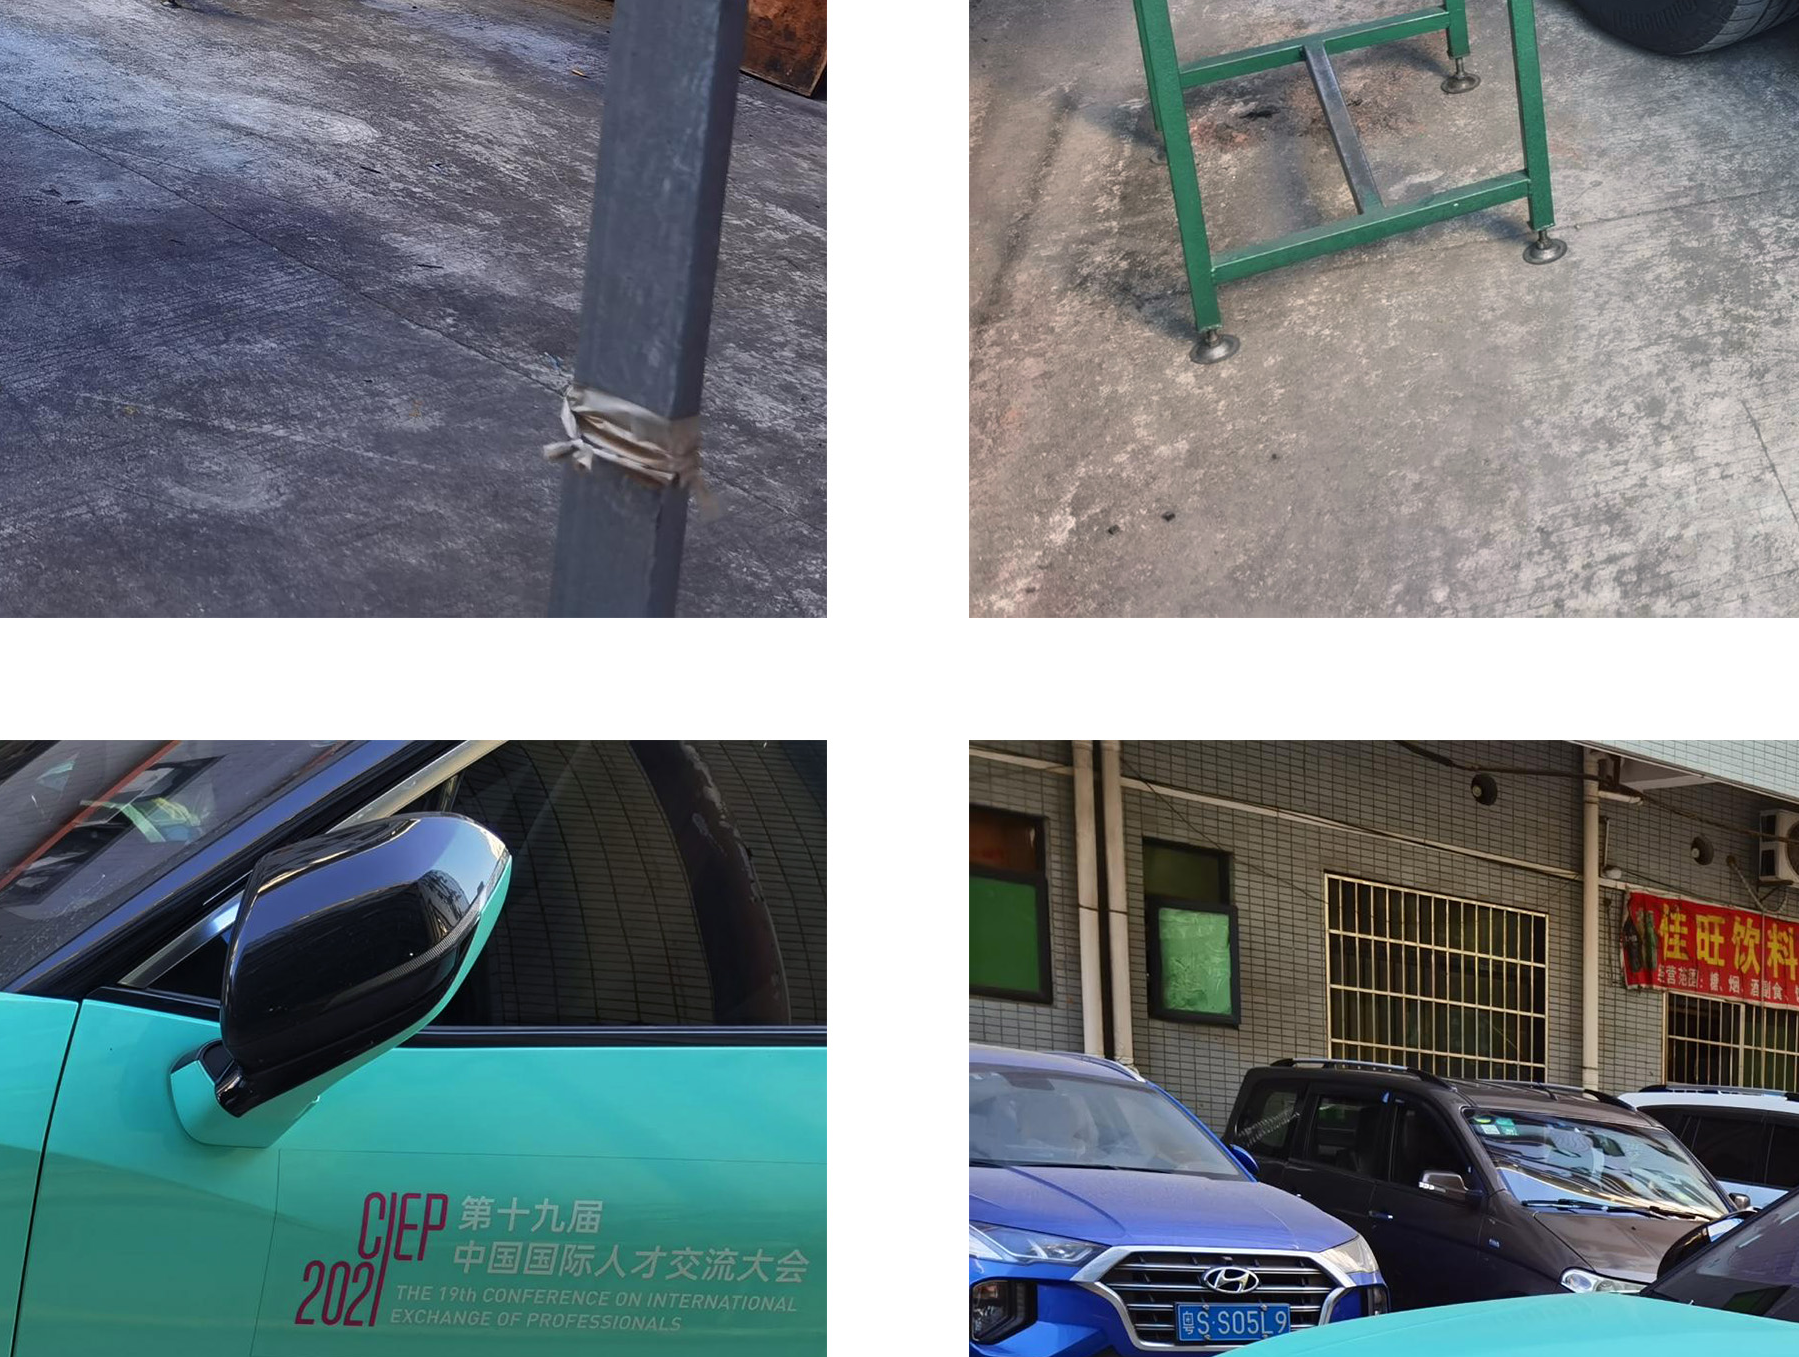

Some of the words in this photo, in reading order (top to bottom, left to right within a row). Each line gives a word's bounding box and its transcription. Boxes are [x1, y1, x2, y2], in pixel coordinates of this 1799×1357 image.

[357, 1192, 449, 1262] CIEP
[458, 1195, 604, 1235] 第十九届
[452, 1239, 811, 1284] 中国国际人才交流大会
[294, 1259, 388, 1327] 2021
[396, 1285, 433, 1301] THE
[439, 1285, 477, 1303] 19th
[482, 1287, 610, 1307] CONFERENCE
[614, 1291, 642, 1308] ON
[646, 1292, 799, 1313] INTERNATIONAL
[390, 1308, 492, 1327] EXCHANGE
[496, 1311, 522, 1327] OF
[525, 1311, 683, 1332] PROFESSIONALS
